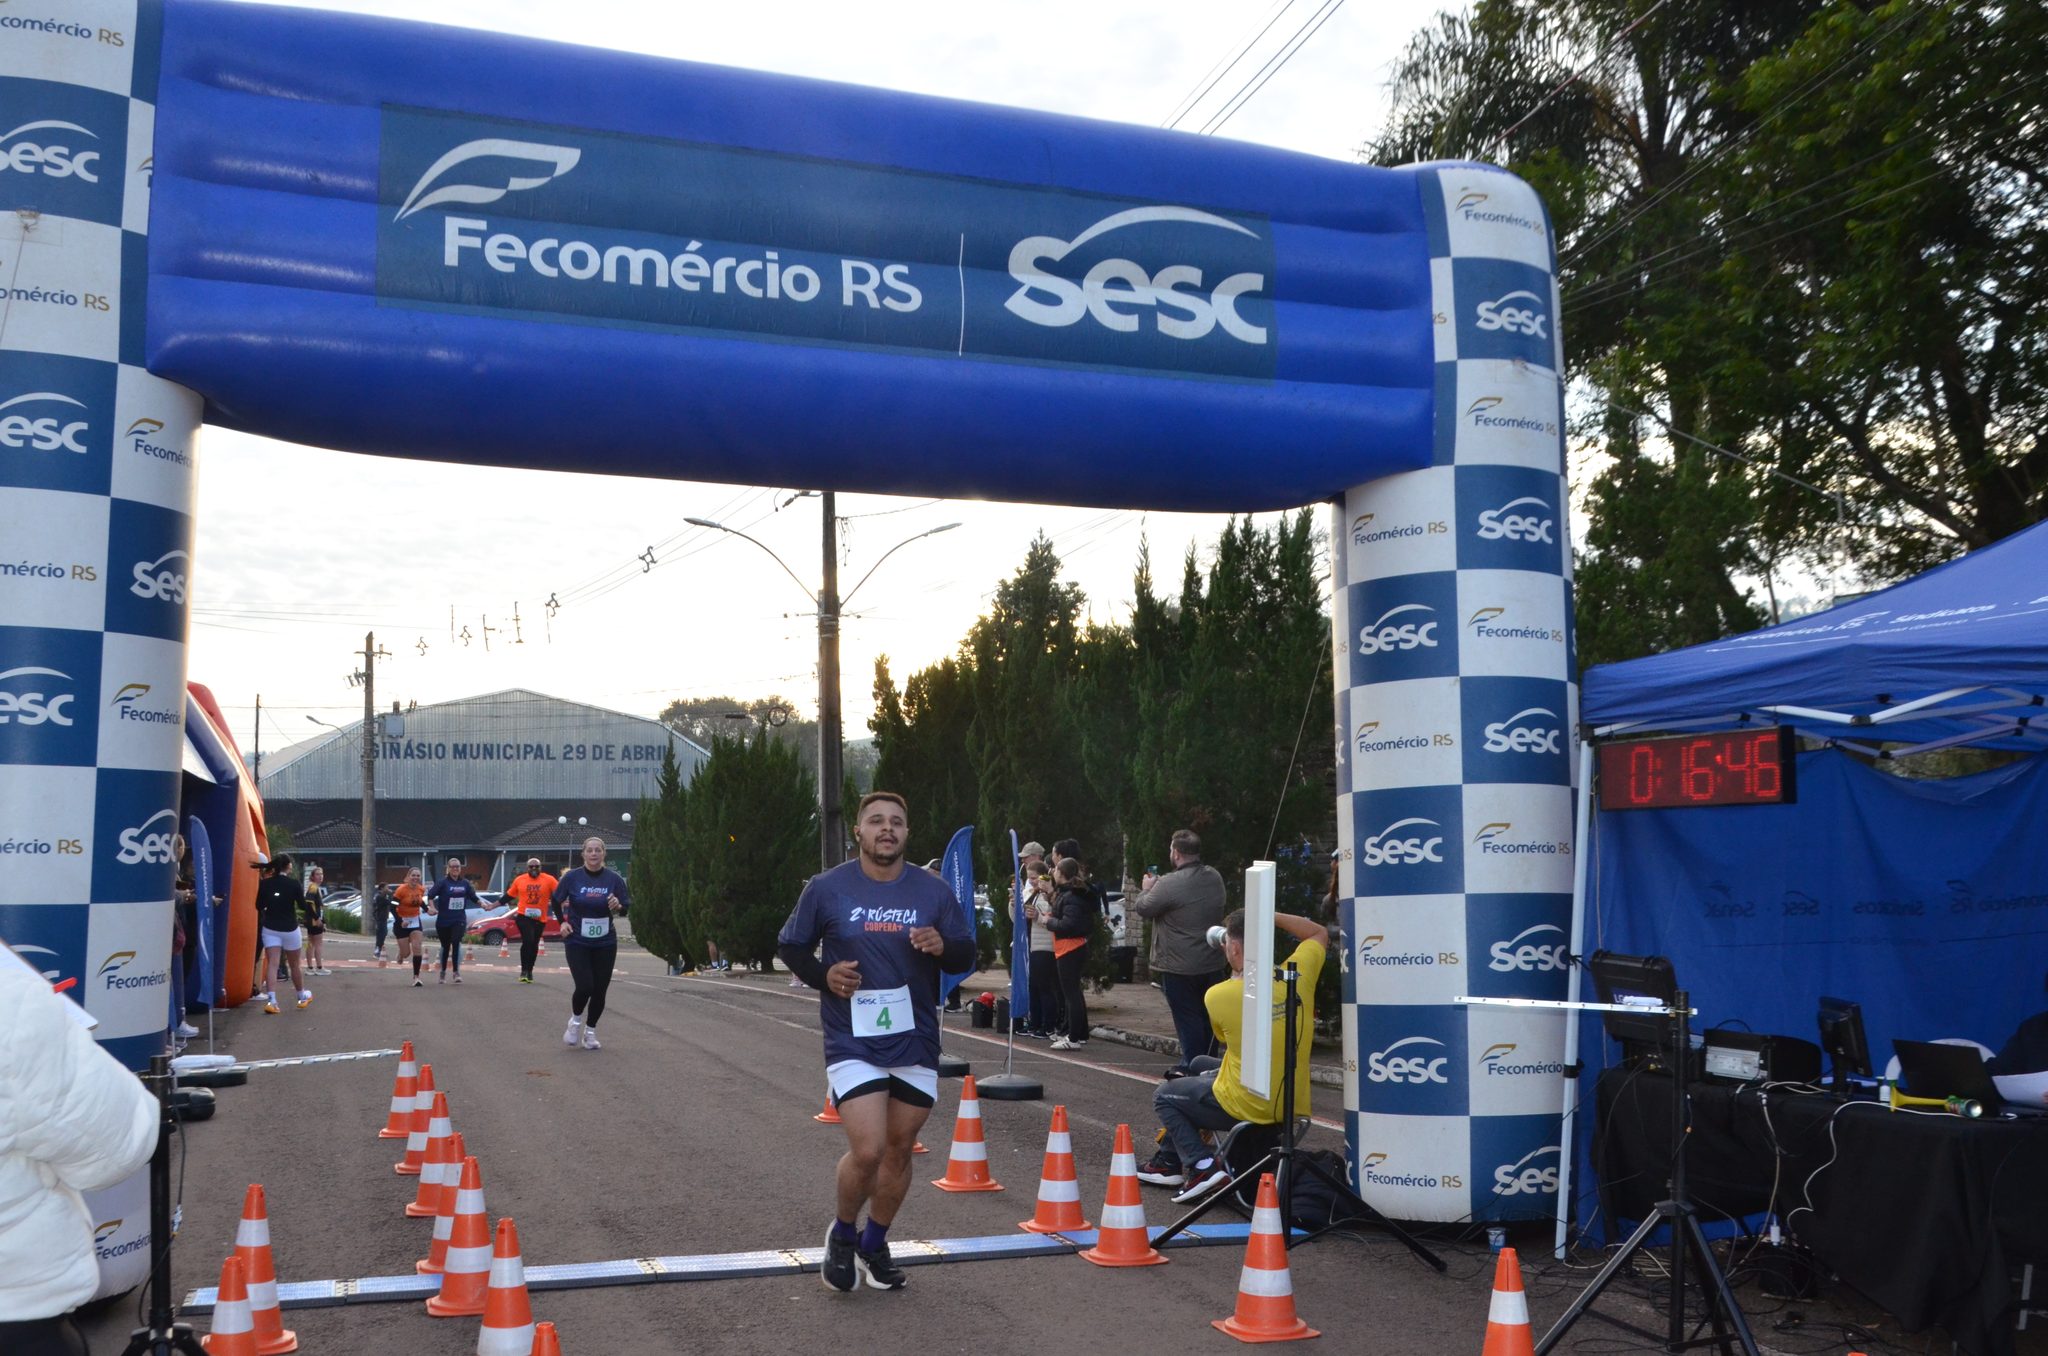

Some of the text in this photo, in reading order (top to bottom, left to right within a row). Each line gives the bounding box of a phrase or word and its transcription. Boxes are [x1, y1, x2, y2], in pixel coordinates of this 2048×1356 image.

[0, 16, 125, 47] comércio RS
[0, 142, 99, 183] esc
[1465, 210, 1531, 229] Fecomércio
[444, 215, 923, 314] Fecomércio RS
[0, 286, 110, 311] omércio RS
[1003, 236, 1267, 345] Sesc
[1476, 301, 1547, 339] Sesc
[0, 416, 88, 454] esc
[1475, 415, 1544, 432] Fecomércio
[1355, 521, 1448, 545] Fecomércio RS
[1477, 510, 1553, 544] Sesc
[0, 561, 97, 581] mércio RS
[1359, 621, 1438, 656] Sesc
[1477, 625, 1549, 641] Fecomércio
[1551, 629, 1563, 643] RS
[0, 691, 75, 726] esc
[1359, 734, 1453, 753] Fecomércio RS
[1483, 723, 1560, 755] Sesc
[452, 743, 556, 760] MUNICIPAL
[563, 744, 587, 760] 29
[592, 745, 615, 761] DE
[0, 838, 83, 854] ércio RS
[1364, 836, 1443, 867] Sesc
[1483, 839, 1571, 855] Fecomércio RS
[588, 925, 602, 936] 80
[1363, 953, 1433, 966] Fecomércio
[1438, 952, 1459, 966] RS
[1488, 942, 1567, 973] Sesc
[876, 1007, 892, 1030] 4
[1368, 1052, 1448, 1084] Sesc
[1488, 1062, 1562, 1076] Fecomércio
[1367, 1170, 1437, 1188] Fecomércio
[1441, 1175, 1462, 1188] RS
[1492, 1164, 1571, 1196] Ses
